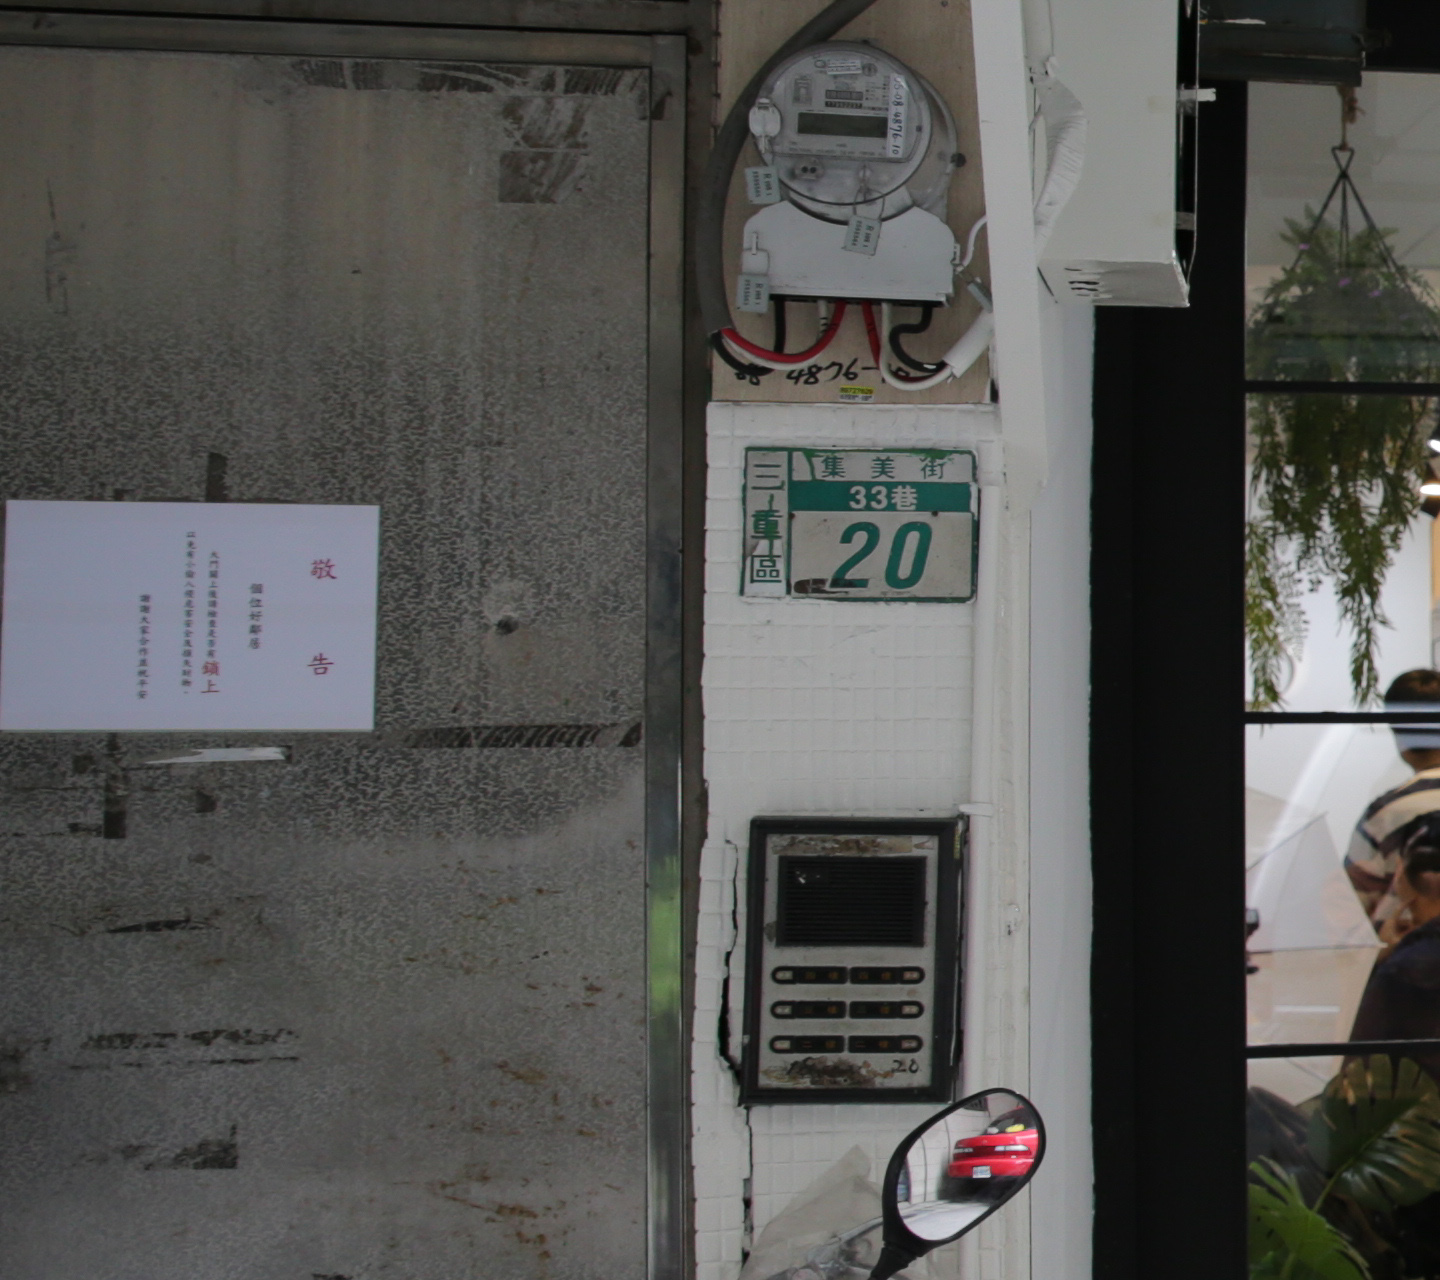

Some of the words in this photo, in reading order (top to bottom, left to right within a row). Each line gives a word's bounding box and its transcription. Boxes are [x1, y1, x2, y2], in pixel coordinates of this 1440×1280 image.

[820, 455, 947, 480] 集美街
[848, 485, 919, 511] 33巷
[748, 463, 786, 585] 三重區
[828, 520, 933, 590] 20
[308, 558, 337, 676] 敬告
